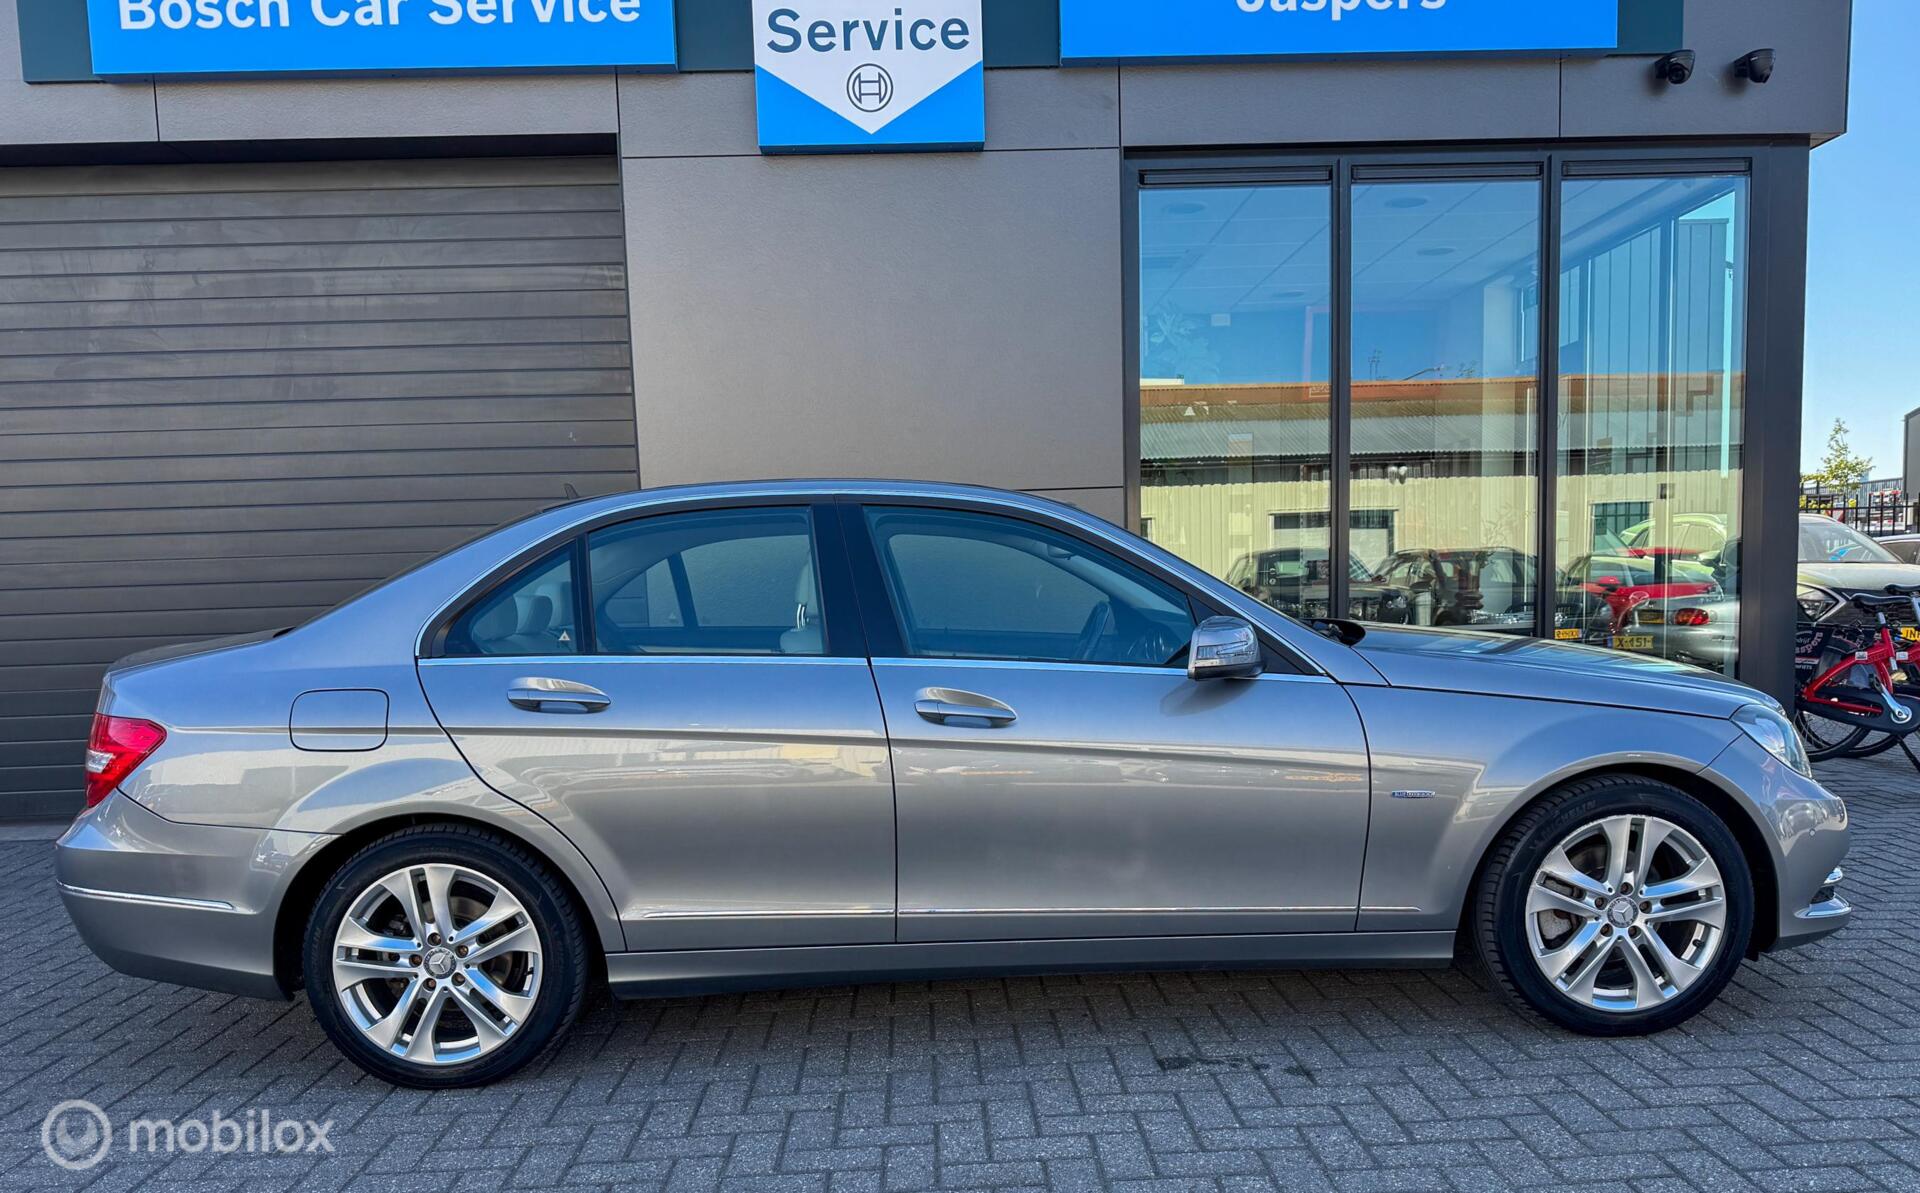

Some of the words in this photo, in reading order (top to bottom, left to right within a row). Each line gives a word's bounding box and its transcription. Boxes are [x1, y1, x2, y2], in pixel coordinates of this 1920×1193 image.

[119, 0, 290, 30] Bosch
[311, 0, 408, 26] Car
[428, 0, 640, 25] Service
[767, 8, 970, 53] Service
